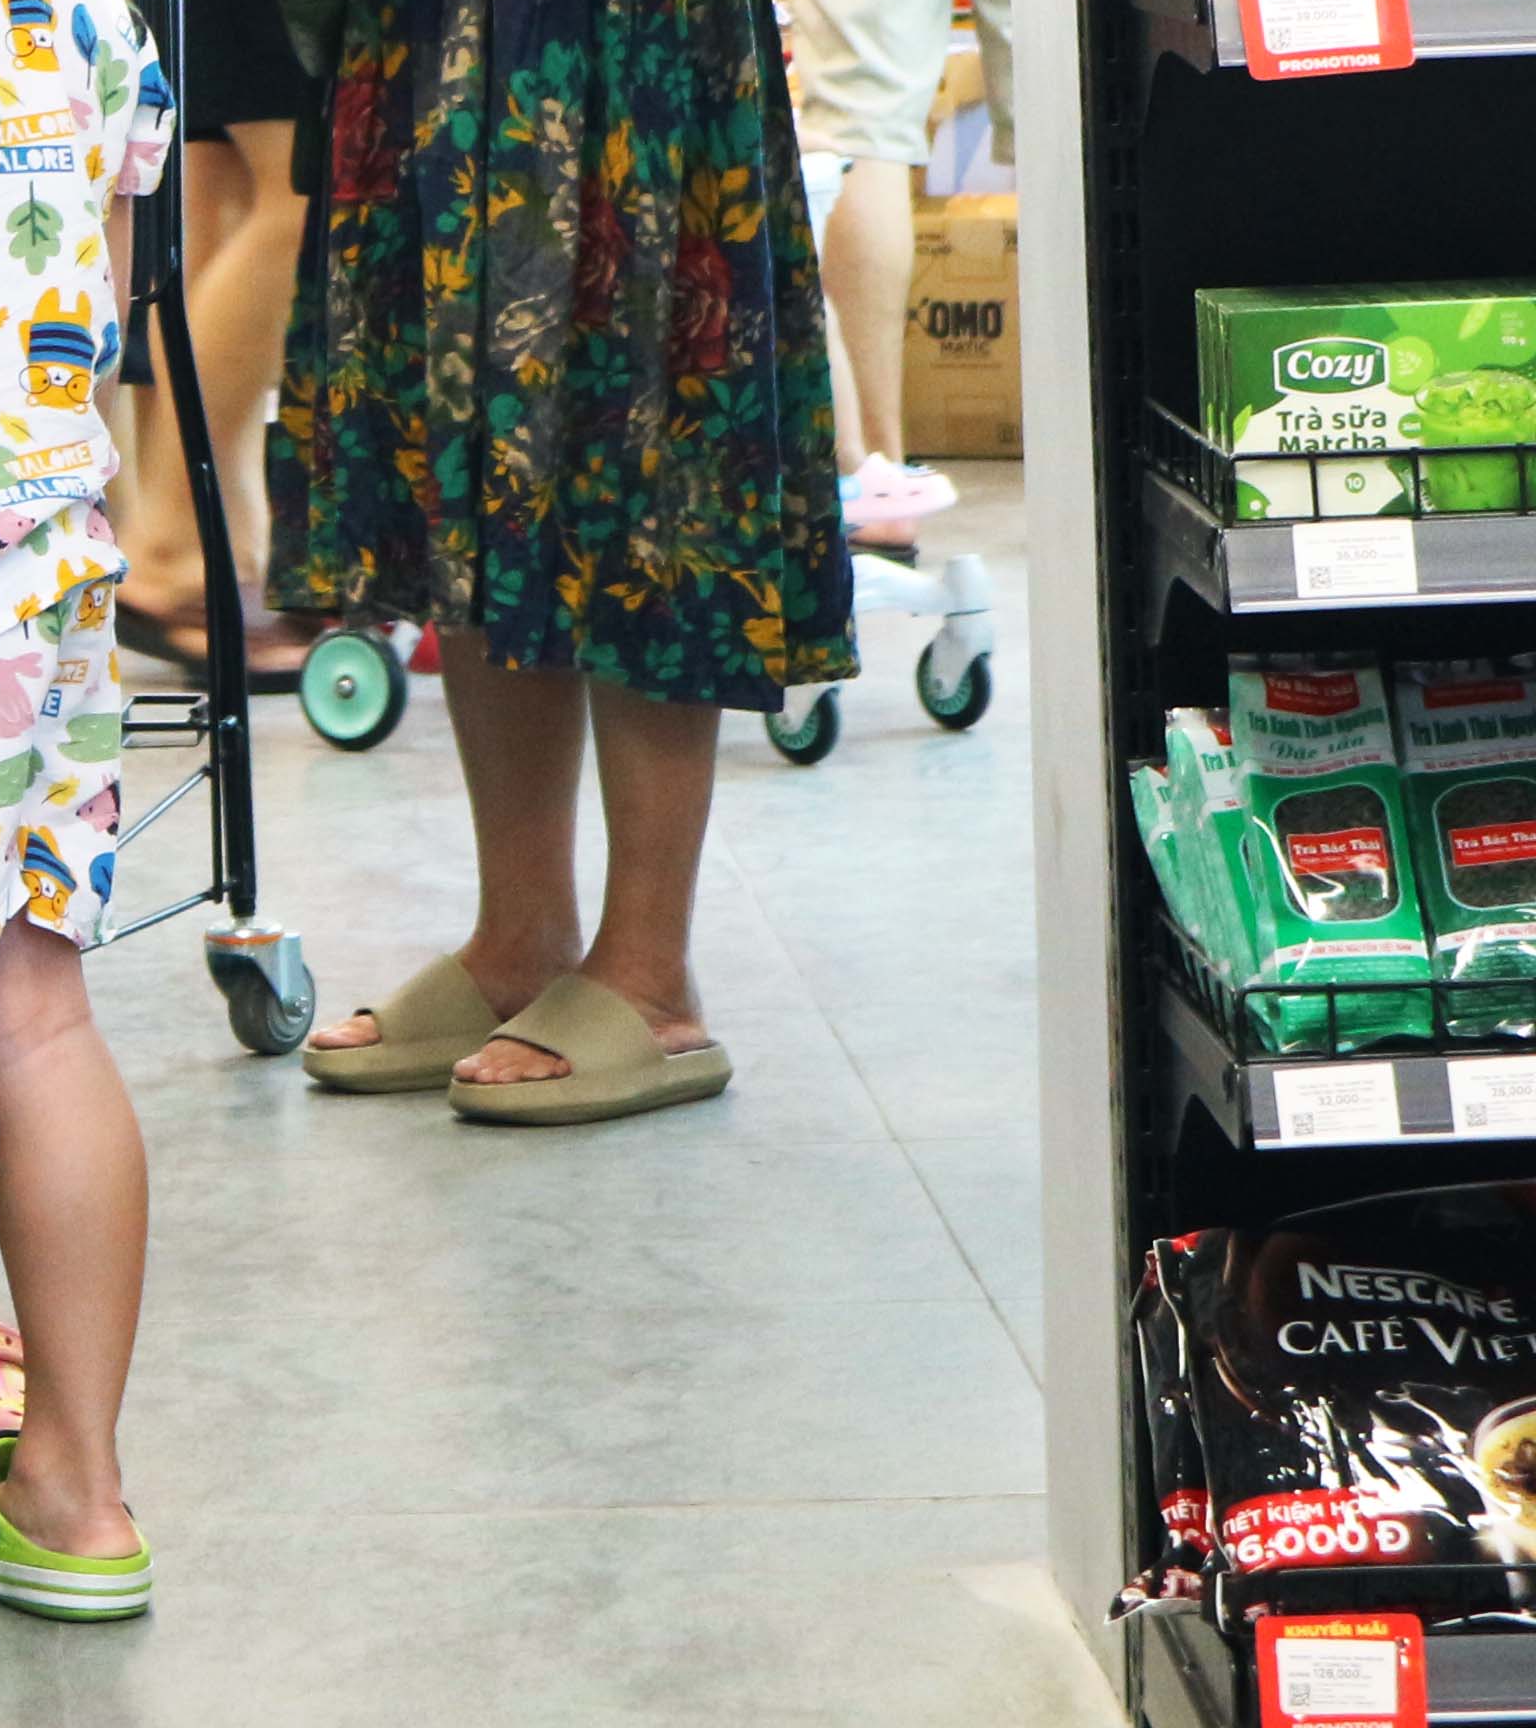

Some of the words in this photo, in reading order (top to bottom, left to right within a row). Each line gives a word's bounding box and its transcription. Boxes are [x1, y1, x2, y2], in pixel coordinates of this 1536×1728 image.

[1279, 53, 1381, 72] PROMOTION
[928, 300, 1003, 339] OMO
[1286, 349, 1376, 387] Cozy
[1276, 406, 1323, 432] Trà
[1332, 404, 1388, 431] sữa
[1278, 432, 1388, 453] Matcha
[1347, 476, 1362, 490] 10
[1296, 1260, 1520, 1324] NESCAFÉ
[1277, 1314, 1407, 1355] CAFÉ
[1266, 1498, 1326, 1527] KIỆM
[1375, 1518, 1410, 1554] Đ
[1284, 1622, 1354, 1638] KHUYẾN
